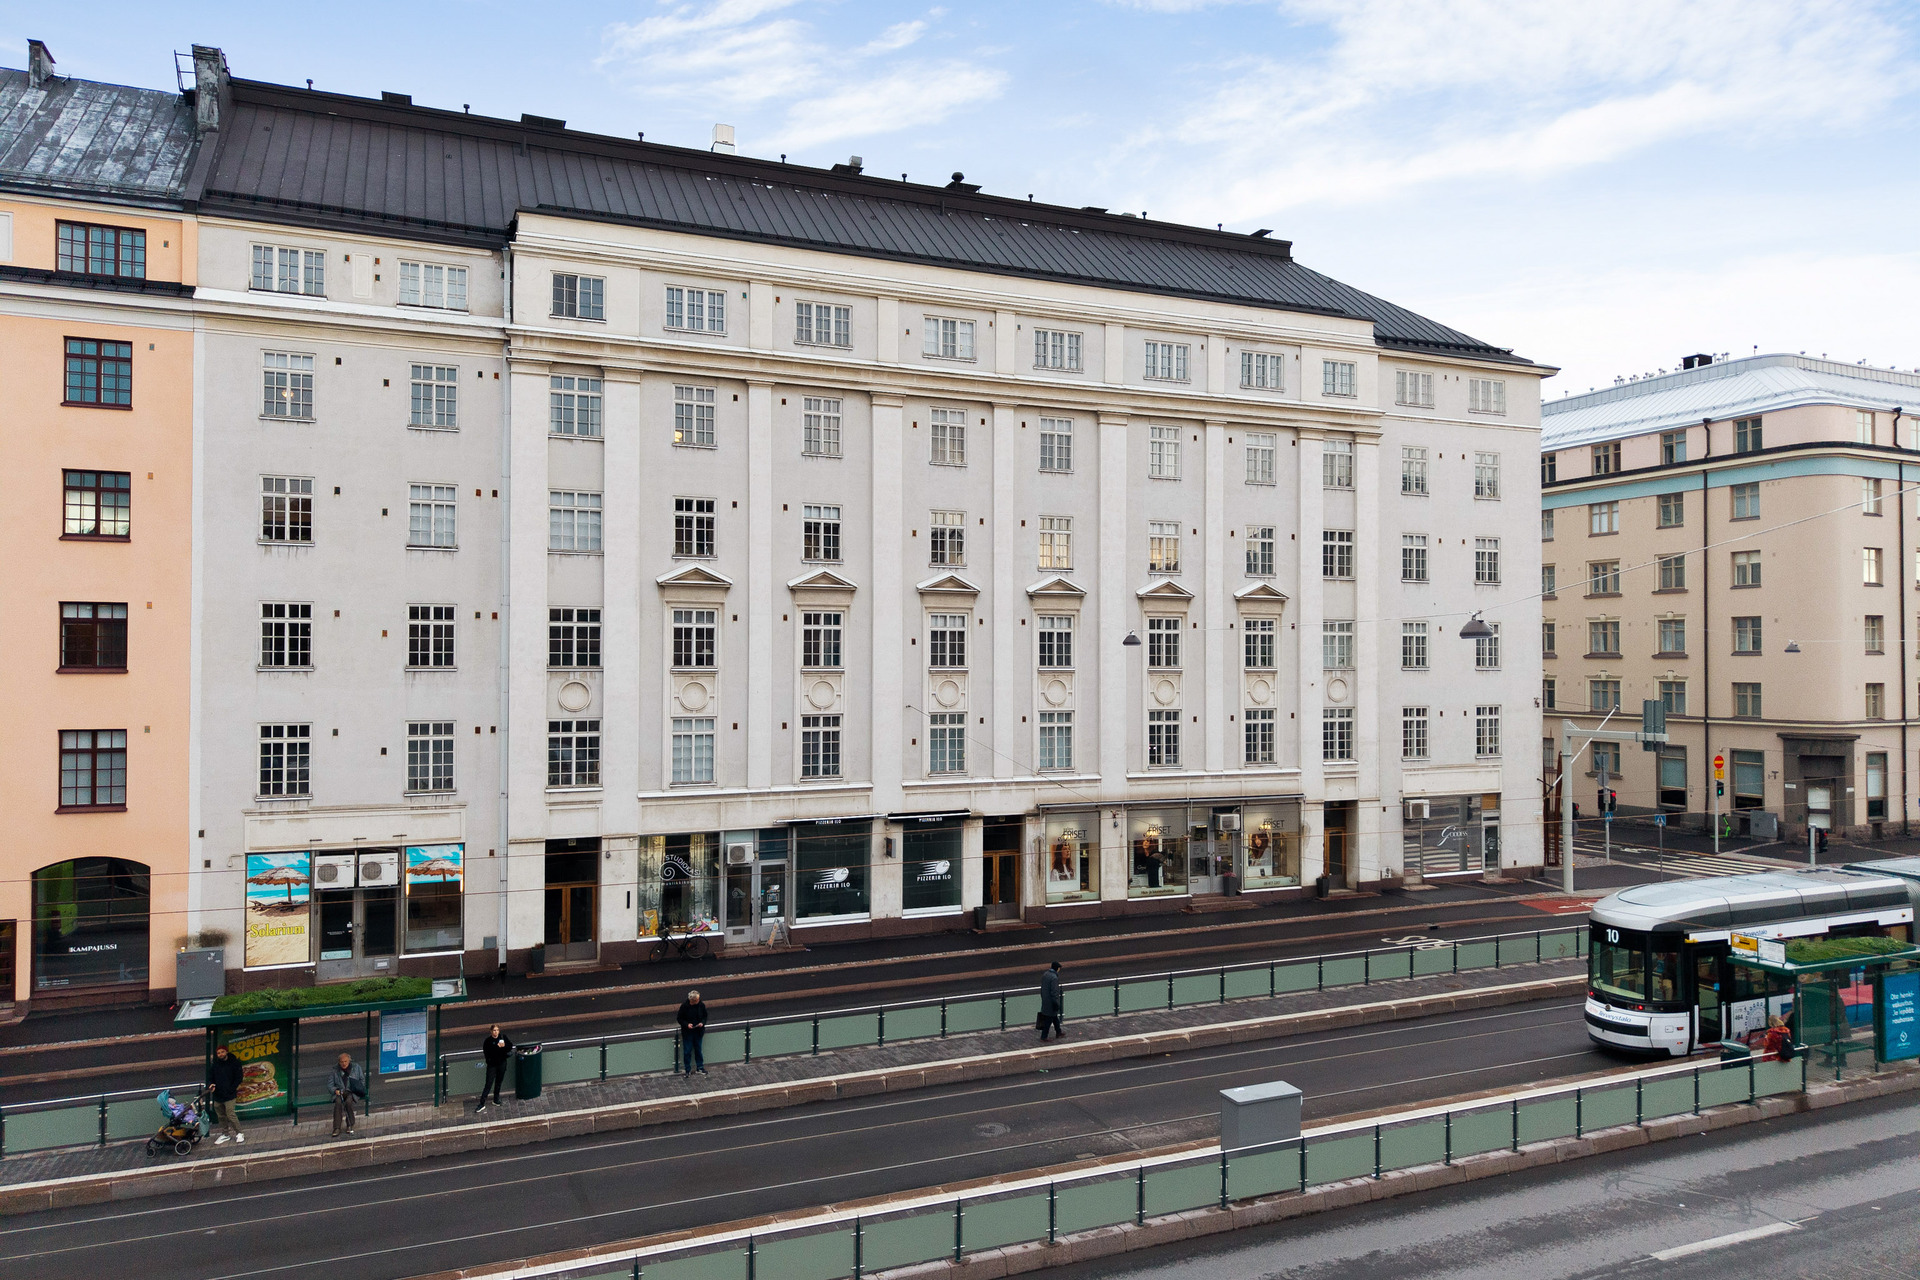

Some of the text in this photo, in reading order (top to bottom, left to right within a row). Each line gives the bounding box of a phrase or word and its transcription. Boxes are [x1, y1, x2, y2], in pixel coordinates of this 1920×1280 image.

[813, 882, 839, 890] PIZZERIA
[250, 922, 306, 938] Solarium
[1606, 928, 1619, 944] 10
[69, 943, 118, 953] KAMPAJUSSI
[1598, 1010, 1632, 1023] Terveystalo
[228, 1031, 280, 1051] KOREAN
